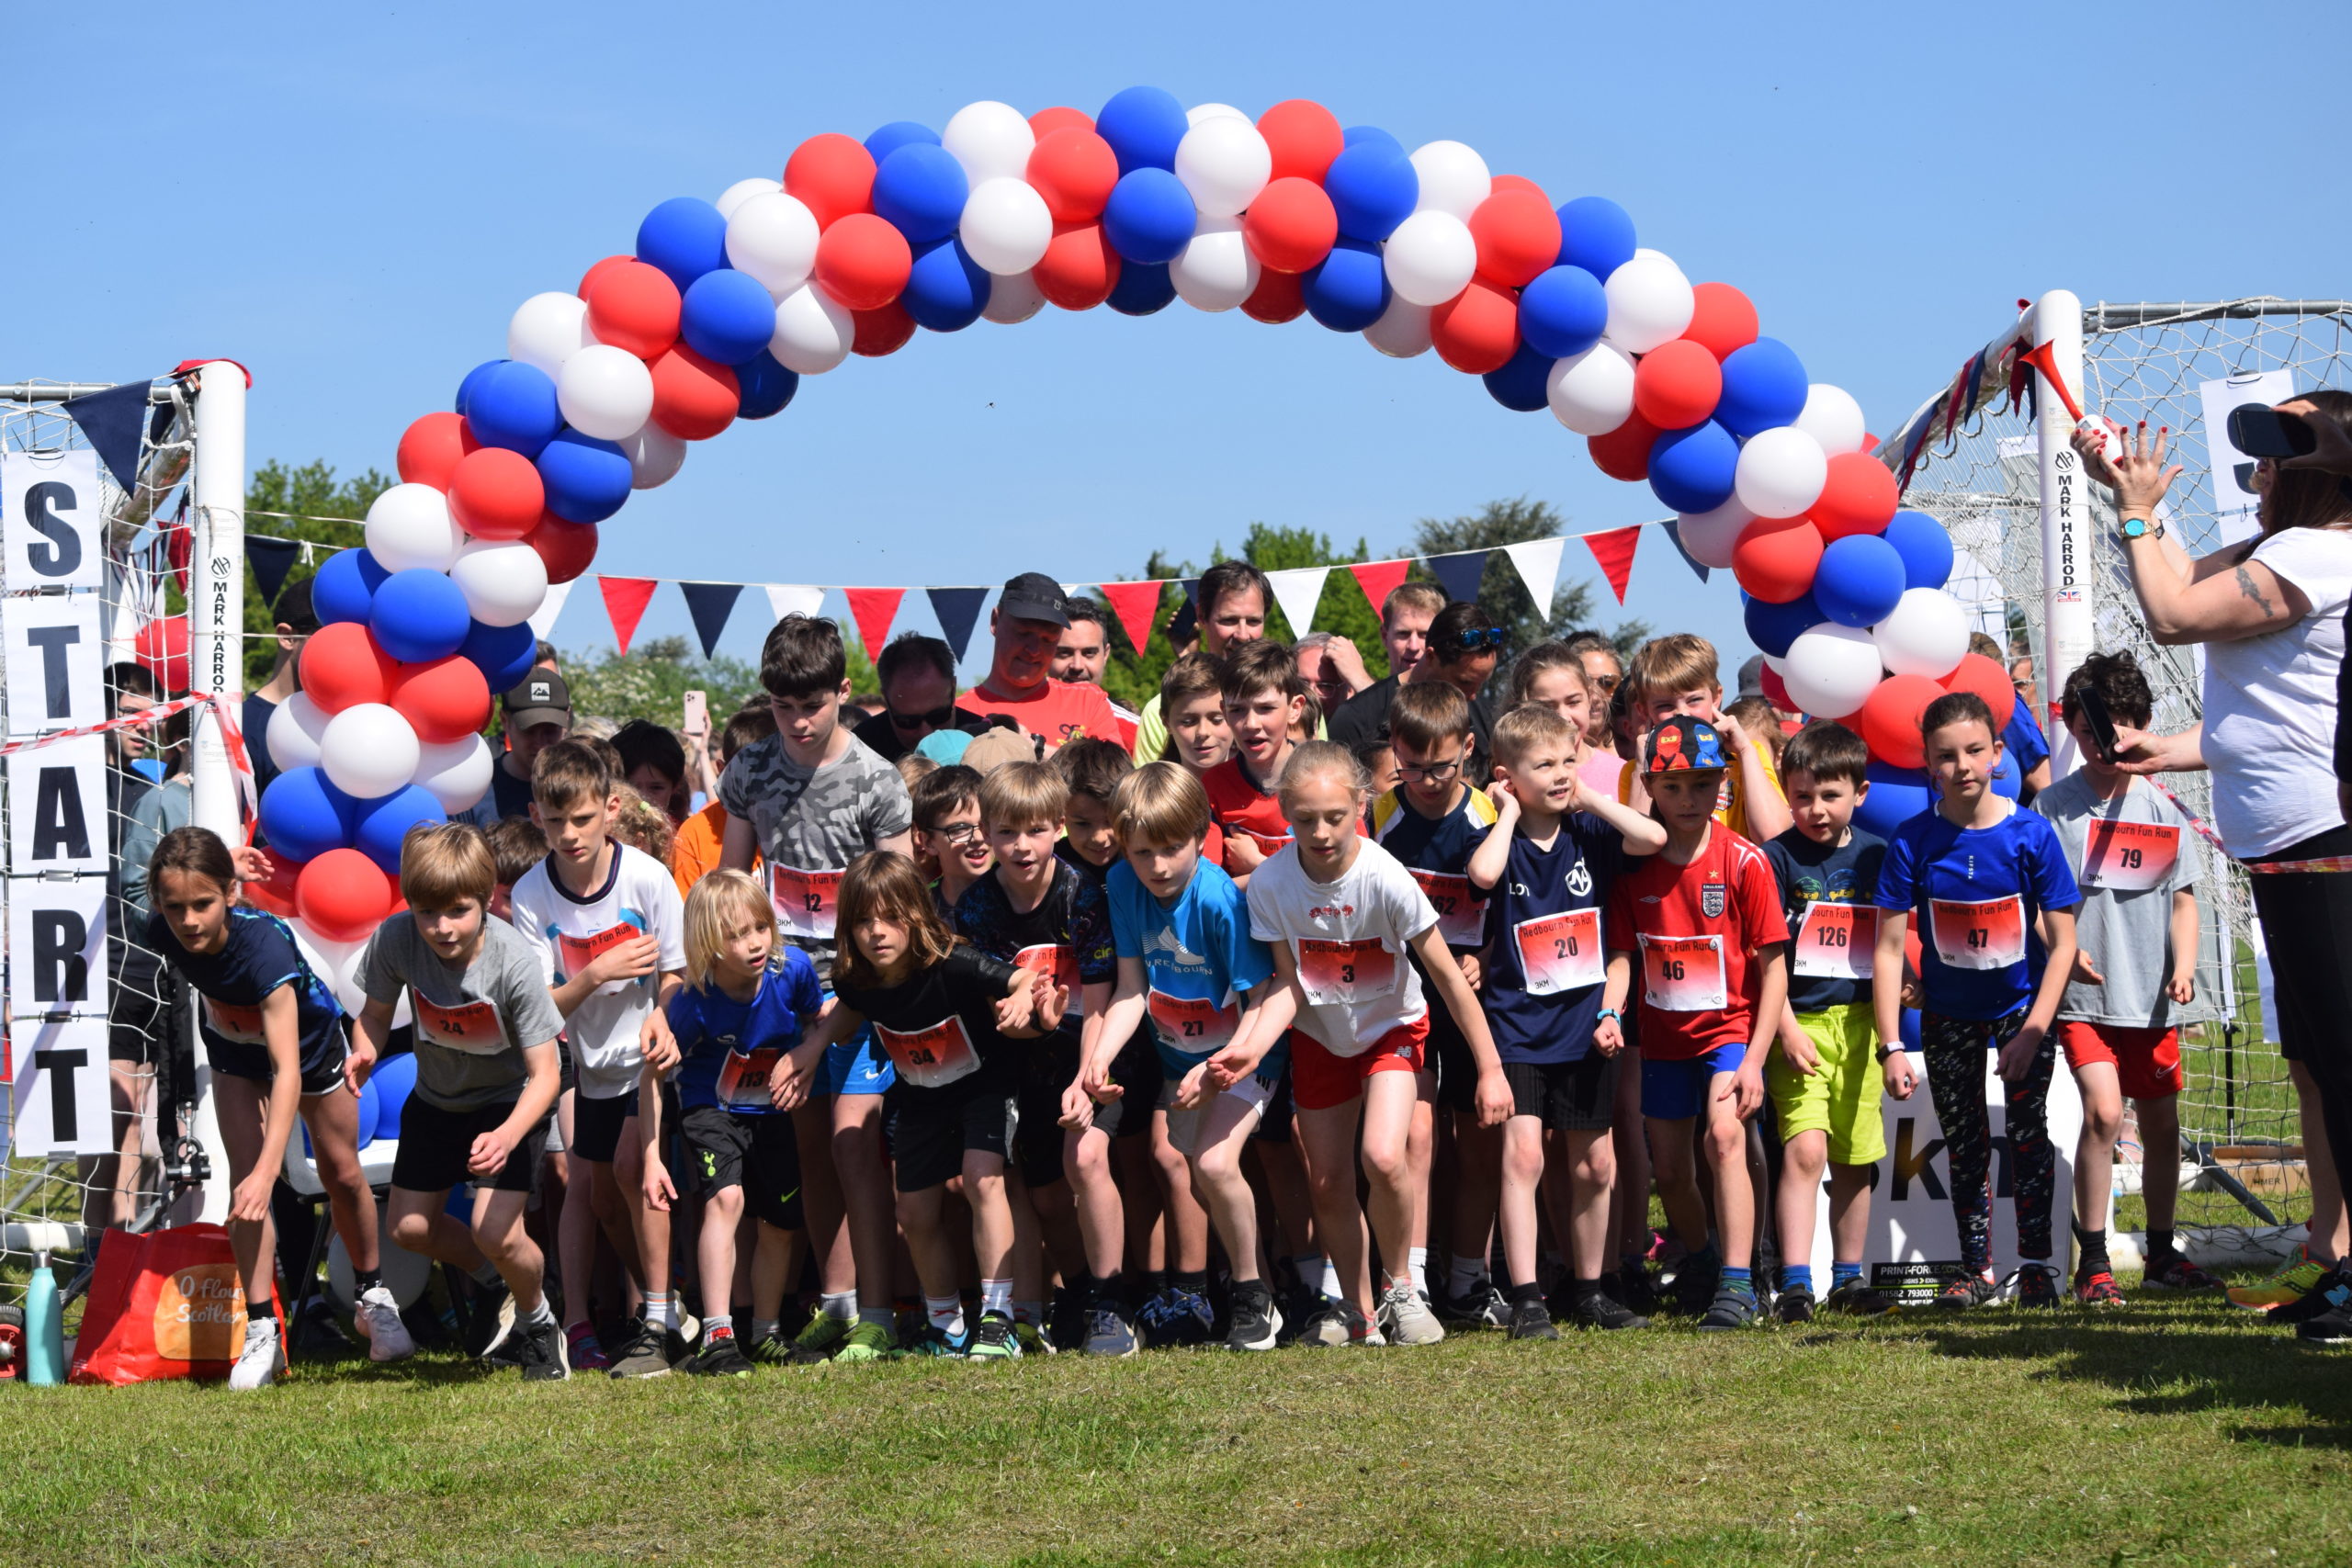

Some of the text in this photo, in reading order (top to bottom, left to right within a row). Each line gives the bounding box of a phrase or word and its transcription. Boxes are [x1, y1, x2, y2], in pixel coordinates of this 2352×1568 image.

[2058, 475, 2073, 517] MARK
[2061, 522, 2075, 586] HARROD
[213, 582, 228, 626] MARK
[24, 480, 93, 1142] START
[2096, 821, 2172, 839] Redbourn Fun Run
[2120, 848, 2143, 869] 79
[813, 874, 829, 885] Fun
[2086, 873, 2103, 882] 3KM
[803, 893, 822, 912] 12
[1939, 901, 2012, 916] Redbourn Fun Run
[1836, 908, 1850, 919] Fun
[777, 919, 792, 927] 3KM
[1523, 920, 1564, 938] Redbourn
[1581, 915, 1592, 925] Run
[598, 931, 615, 944] Fun
[615, 924, 631, 937] Run
[1817, 927, 1847, 947] 126
[1967, 929, 1987, 948] 47
[1555, 937, 1578, 959] 20
[1674, 941, 1691, 953] Fun
[1016, 950, 1047, 964] dbourn
[1794, 959, 1807, 967] 3KM
[1341, 964, 1355, 983] 3
[1662, 960, 1685, 980] 46
[1534, 979, 1549, 989] 3KM
[1308, 991, 1321, 999] KM
[439, 1020, 465, 1035] 24
[1182, 1020, 1204, 1037] 27
[908, 1048, 936, 1066] 34
[736, 1071, 766, 1089] 113
[1878, 1289, 1934, 1298] 01582 793000
[175, 1302, 248, 1324] Scotla
